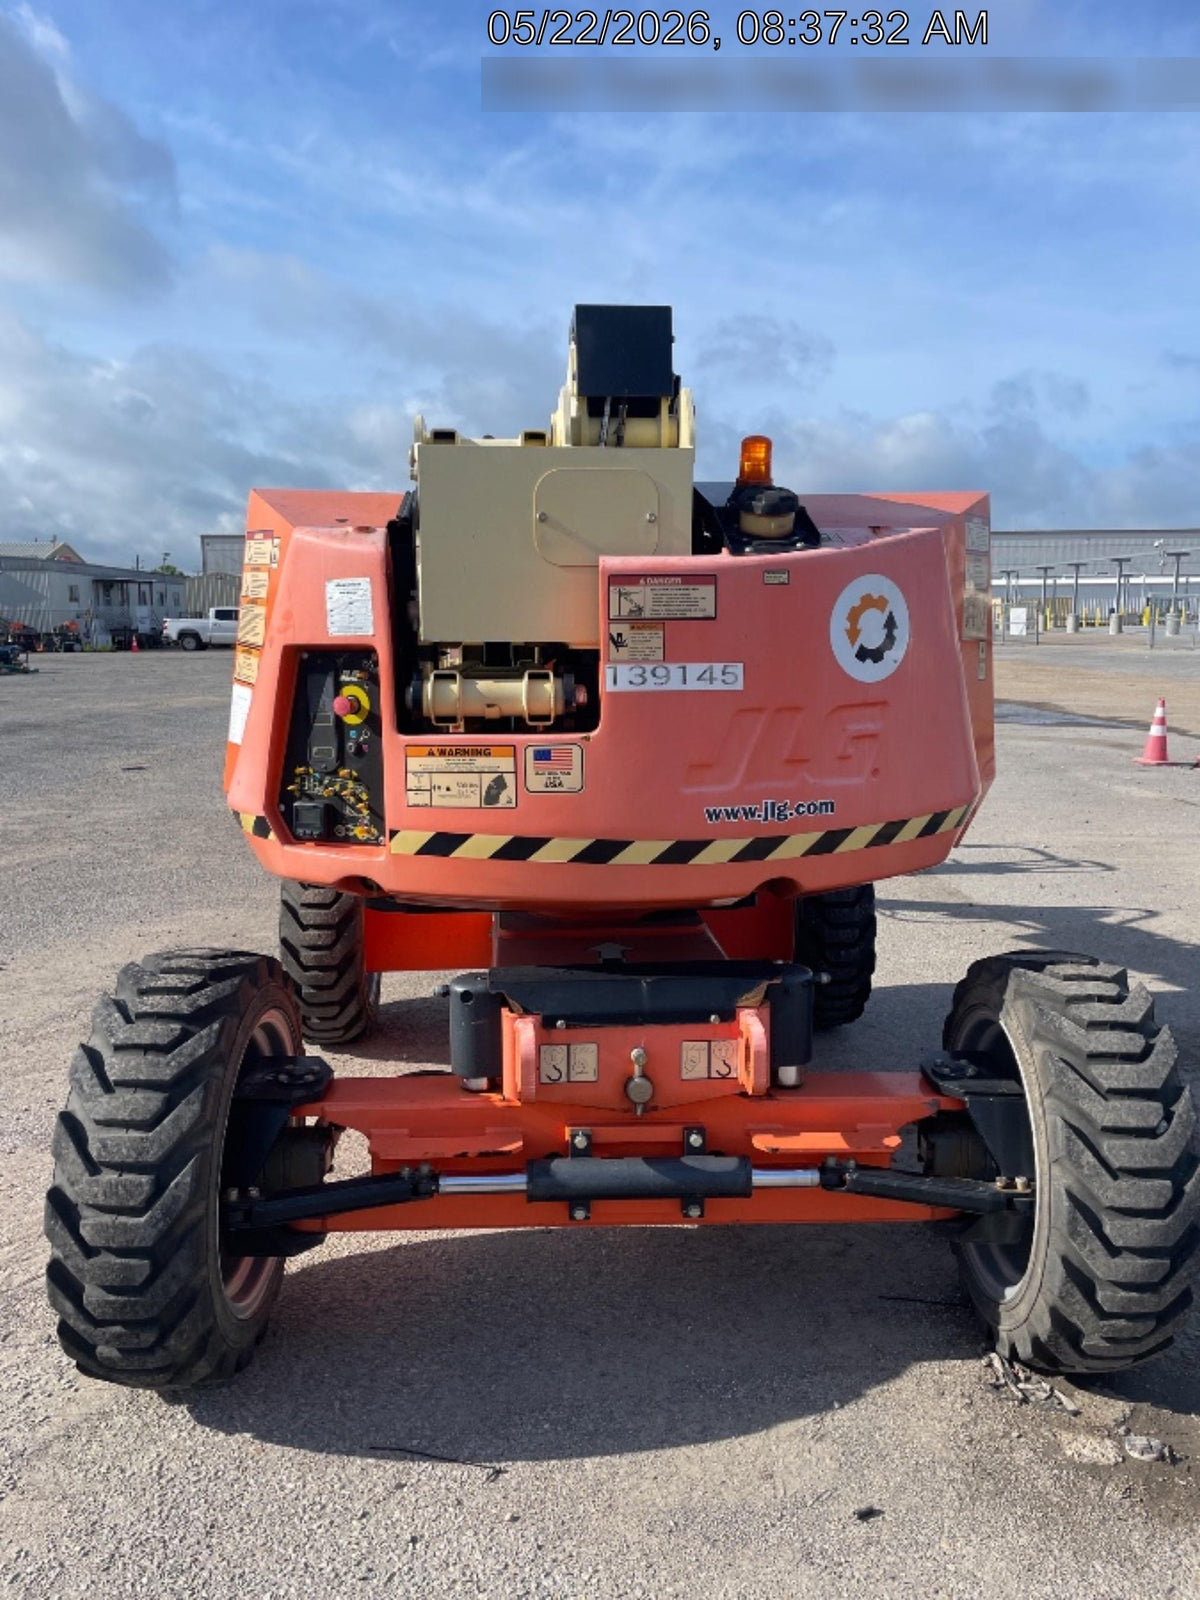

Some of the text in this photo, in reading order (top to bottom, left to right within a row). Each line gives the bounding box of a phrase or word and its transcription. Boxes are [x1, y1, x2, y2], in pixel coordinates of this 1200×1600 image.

[606, 664, 740, 687] 139145
[437, 747, 492, 757] WARNING
[681, 700, 888, 795] JLG
[705, 800, 835, 824] www.jlg.com
